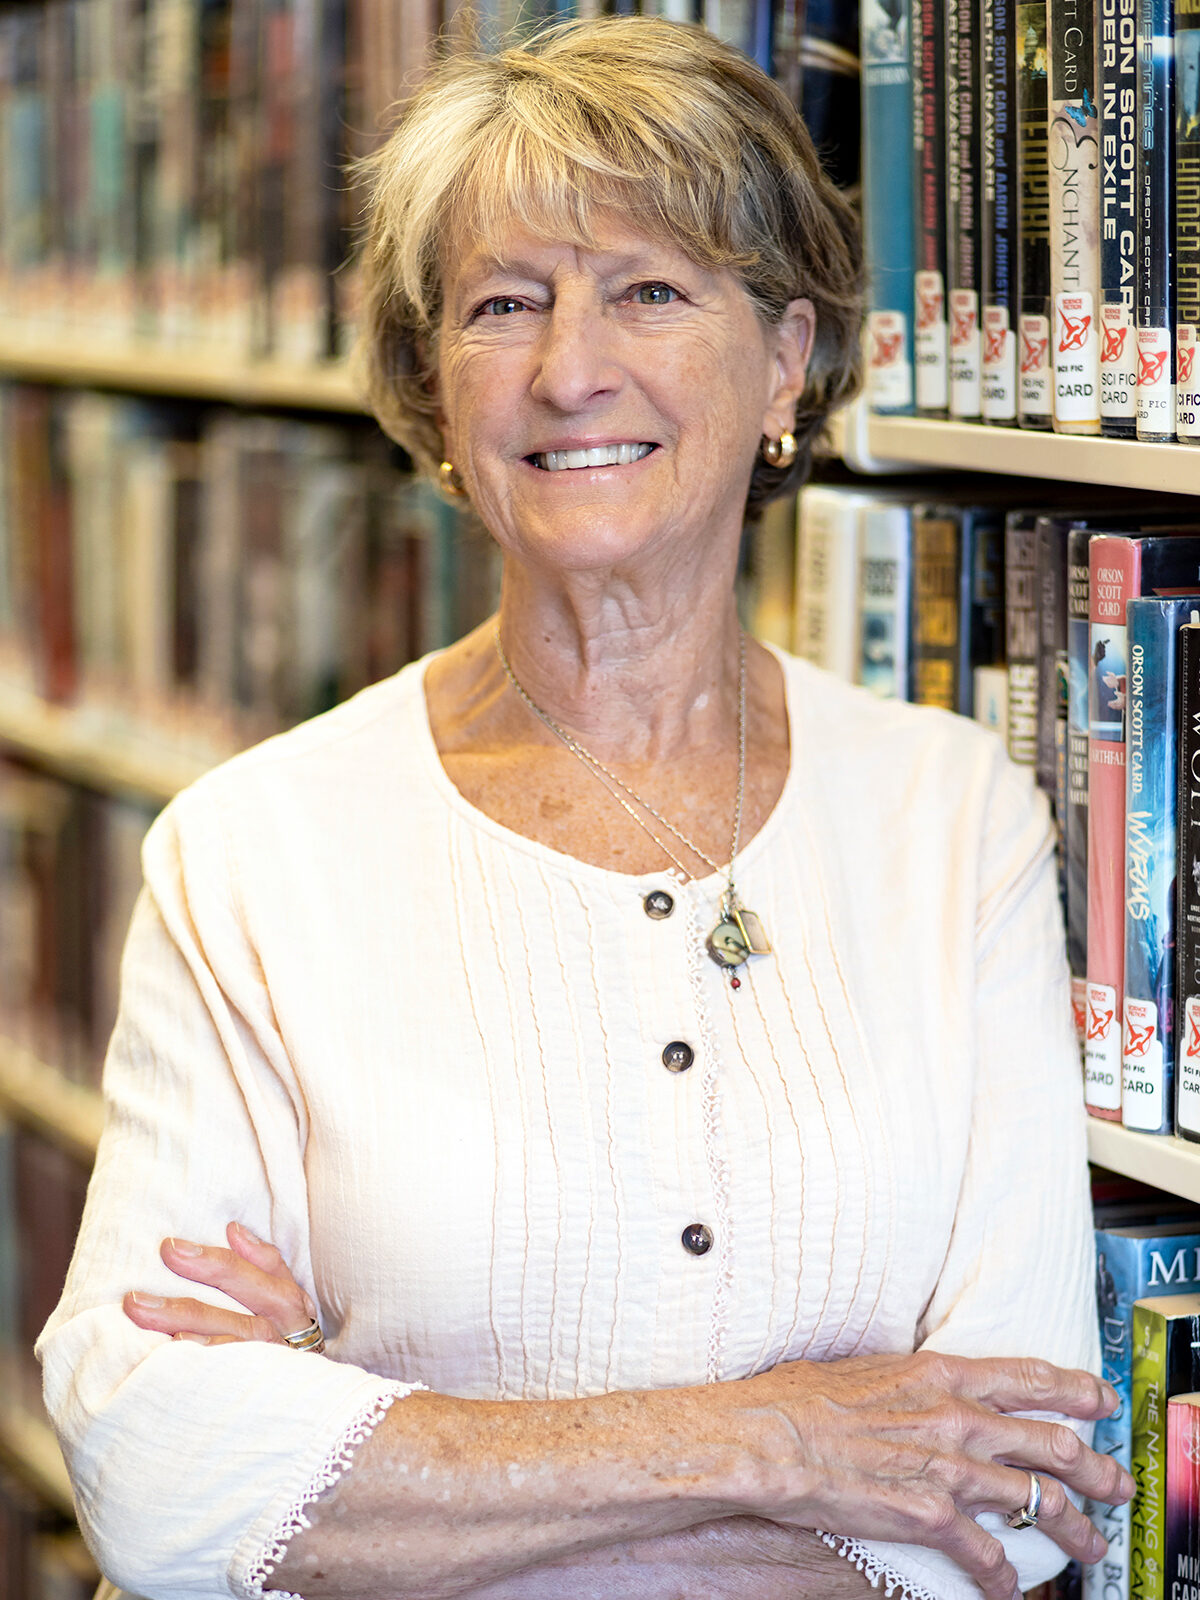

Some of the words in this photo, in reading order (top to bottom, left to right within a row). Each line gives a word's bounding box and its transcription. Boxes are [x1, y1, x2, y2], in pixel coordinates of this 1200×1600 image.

[959, 37, 972, 88] SCOTT
[994, 35, 1008, 87] SCOTT
[1064, 27, 1084, 94] CARD
[959, 91, 973, 136] CARD
[995, 90, 1008, 134] CARD
[1103, 82, 1116, 120] IN
[984, 73, 995, 202] UNAWARE
[995, 138, 1008, 168] and
[1120, 88, 1135, 217] SCOTT
[960, 172, 973, 230] AARON
[995, 172, 1009, 230] AARON
[1021, 121, 1050, 247] EMPIRE
[1049, 116, 1098, 293] ENCHANT
[1103, 134, 1117, 241] EXILE
[1176, 157, 1200, 252] HIDDEN
[1119, 230, 1134, 326] CAR
[1176, 263, 1200, 329] EMP
[1070, 364, 1084, 373] FIC
[1101, 372, 1116, 386] SCI
[1119, 372, 1136, 386] FIC
[1057, 384, 1094, 398] CARD
[1101, 390, 1129, 404] CARD
[1148, 400, 1168, 409] FIC
[1177, 392, 1185, 406] CI
[1186, 393, 1200, 406] FIC
[1136, 410, 1149, 419] ARD
[1177, 412, 1196, 425] ARD
[1096, 584, 1122, 601] SCOTT
[1097, 567, 1124, 583] ORSON
[1098, 601, 1121, 617] CARD
[1131, 644, 1145, 697] ORSON
[1131, 700, 1144, 750] SCOTT
[1131, 751, 1144, 794] CARD
[1126, 810, 1154, 921] WYRMS
[1085, 1070, 1114, 1086] CARD
[1122, 1079, 1155, 1095] CARD
[1133, 1064, 1146, 1074] FIC
[1183, 1065, 1194, 1075] SCI
[1147, 1381, 1159, 1425] THE
[1132, 1461, 1146, 1542] MIKE
[1145, 1430, 1160, 1550] NAMING
